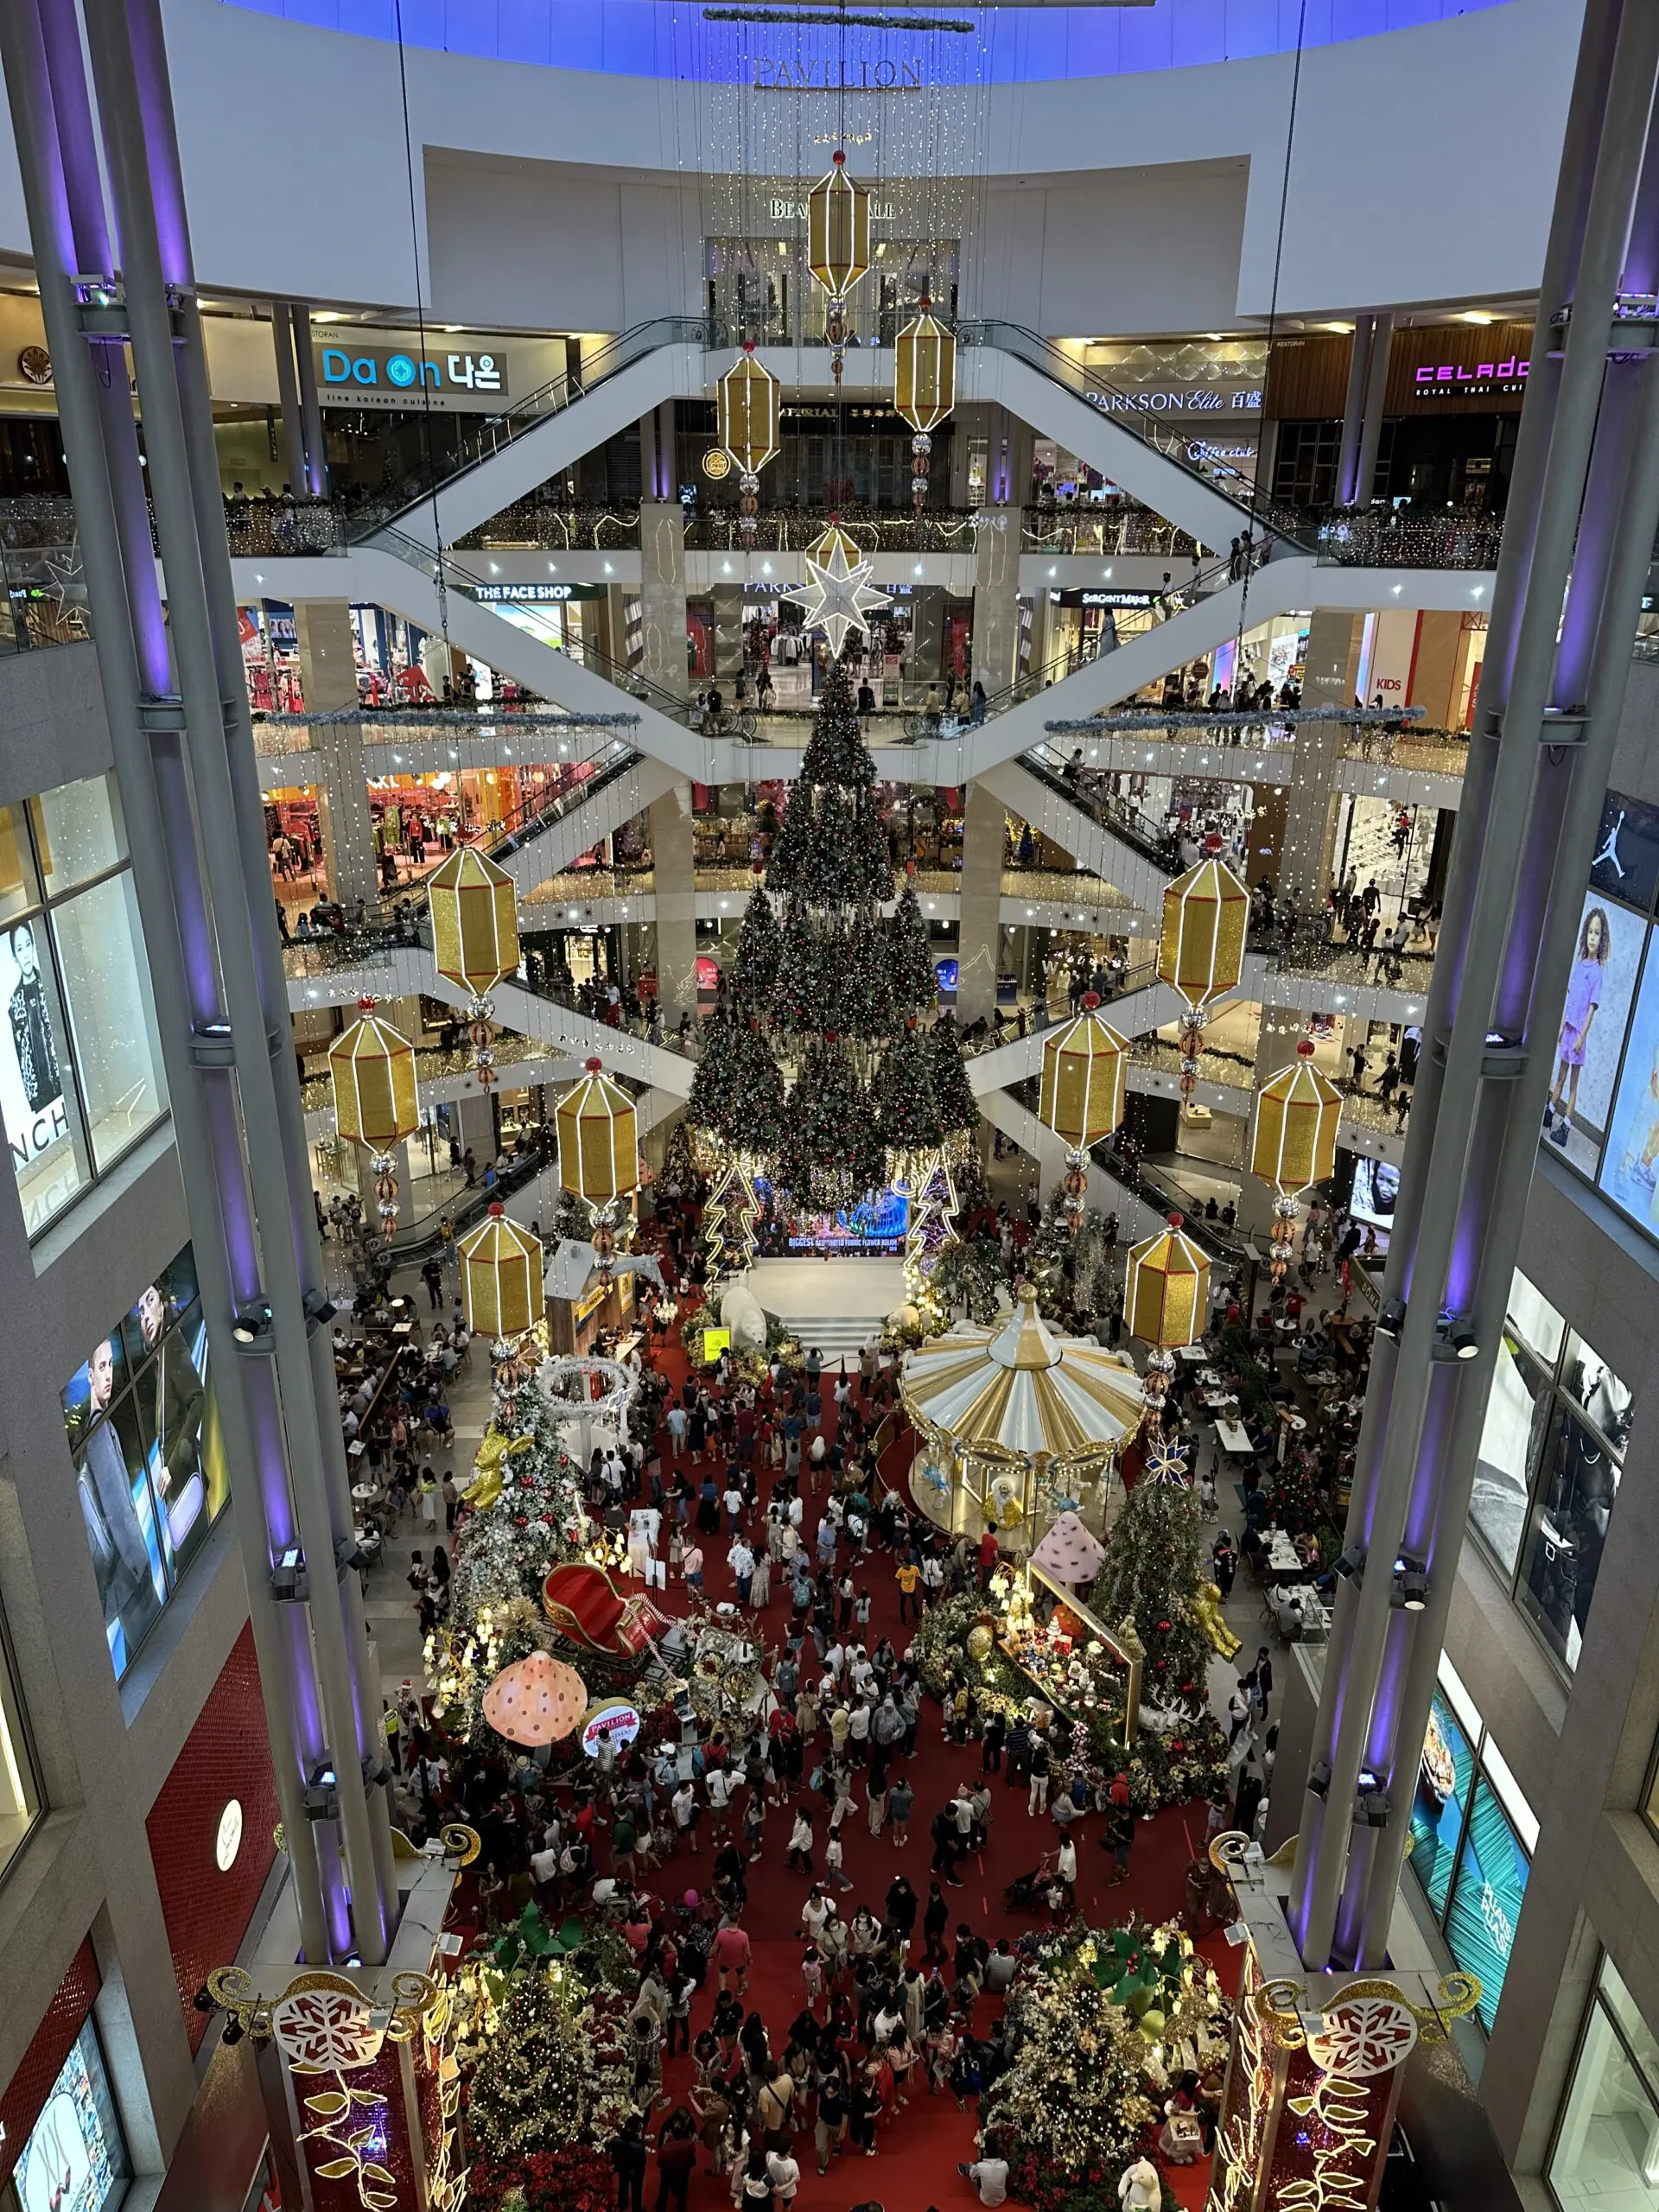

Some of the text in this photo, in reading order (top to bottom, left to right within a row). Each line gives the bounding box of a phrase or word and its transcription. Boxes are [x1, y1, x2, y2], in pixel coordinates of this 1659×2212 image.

[754, 58, 922, 87] PAVILION
[322, 349, 501, 389] Da On 다온
[1185, 390, 1225, 410] Elite
[1231, 391, 1262, 409] 百盛
[475, 586, 572, 599] THE FACE SHOP
[1376, 678, 1402, 690] KIDS
[789, 1237, 814, 1247] BIGGEST
[591, 1713, 631, 1732] PAVILION
